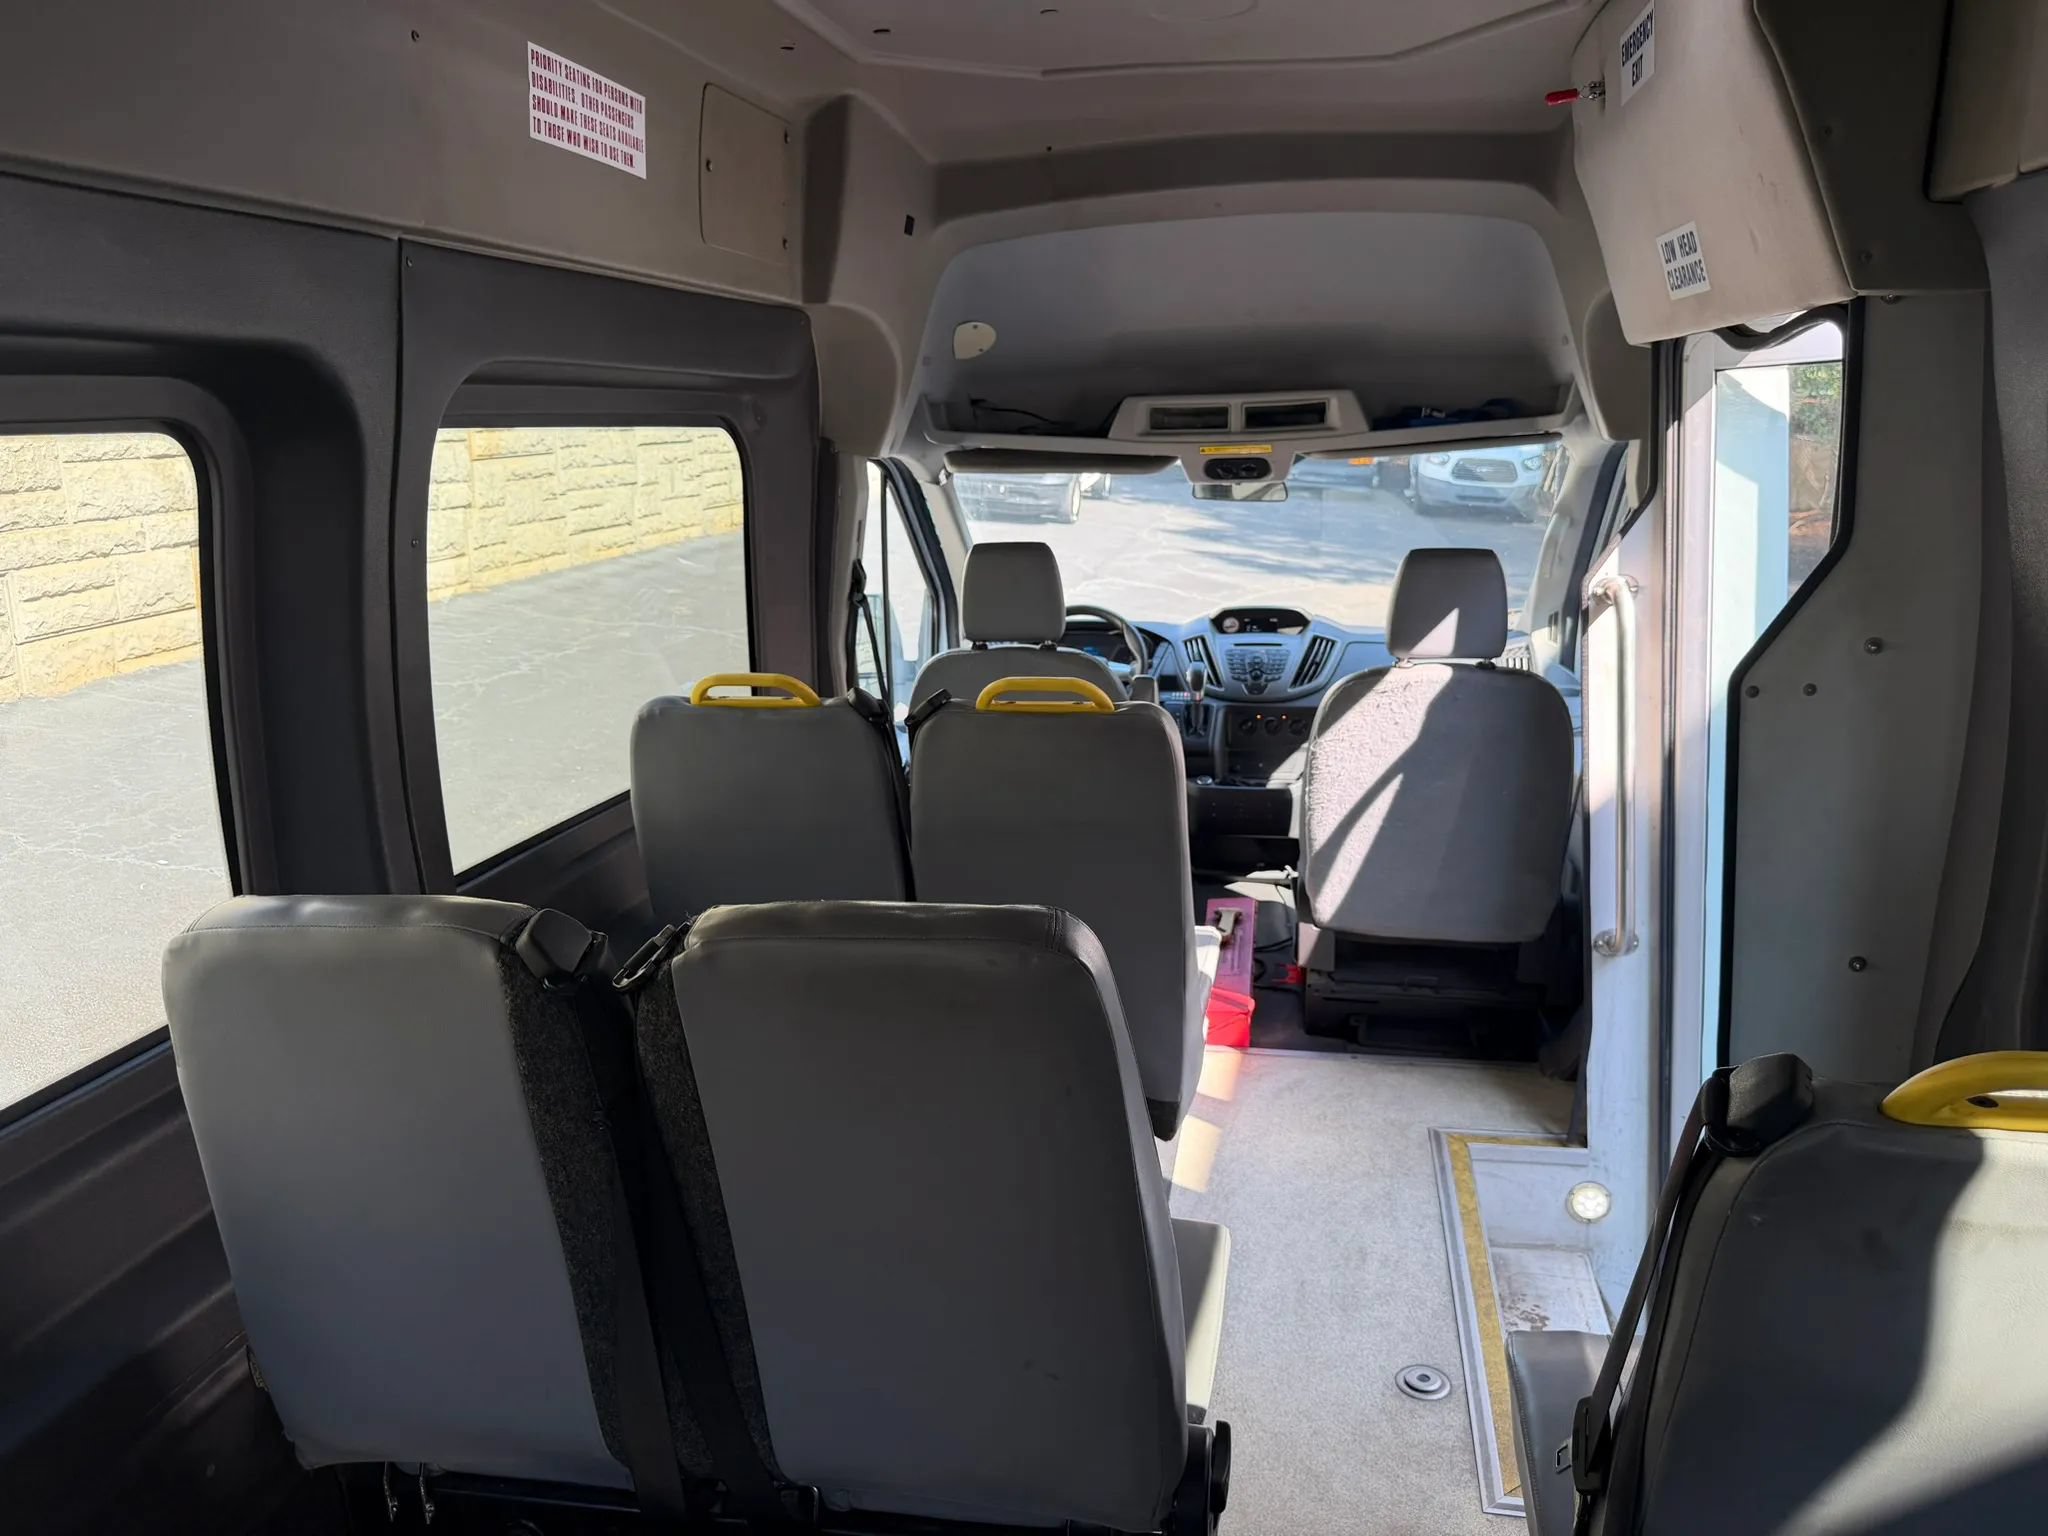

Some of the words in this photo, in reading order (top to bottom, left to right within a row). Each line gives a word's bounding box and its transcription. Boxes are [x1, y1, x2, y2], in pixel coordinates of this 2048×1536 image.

[1622, 9, 1653, 67] EMERGENCY
[531, 48, 562, 77] PRIORITY
[565, 64, 590, 90] SEATING
[592, 77, 602, 95] FOR
[604, 82, 628, 107] PERSONS
[630, 96, 642, 114] WITH
[1632, 54, 1643, 87] EXIT
[532, 71, 578, 105] DISABILITIES.
[581, 92, 599, 114] OTHER
[601, 101, 634, 130] PASSENGERS
[532, 94, 558, 118] SHOULD
[560, 105, 578, 126] MAKE
[580, 112, 597, 134] THESE
[599, 121, 616, 141] SEATS
[618, 129, 644, 153] AVAILABLE
[533, 116, 541, 134] TO
[544, 120, 564, 142] THOSE
[567, 128, 581, 148] WHO
[583, 135, 599, 154] WISH
[600, 141, 608, 158] TO
[609, 145, 619, 163] USE
[1661, 239, 1677, 264] LOW
[1677, 231, 1697, 258] HEAD
[1667, 259, 1706, 291] CLEARANCE
